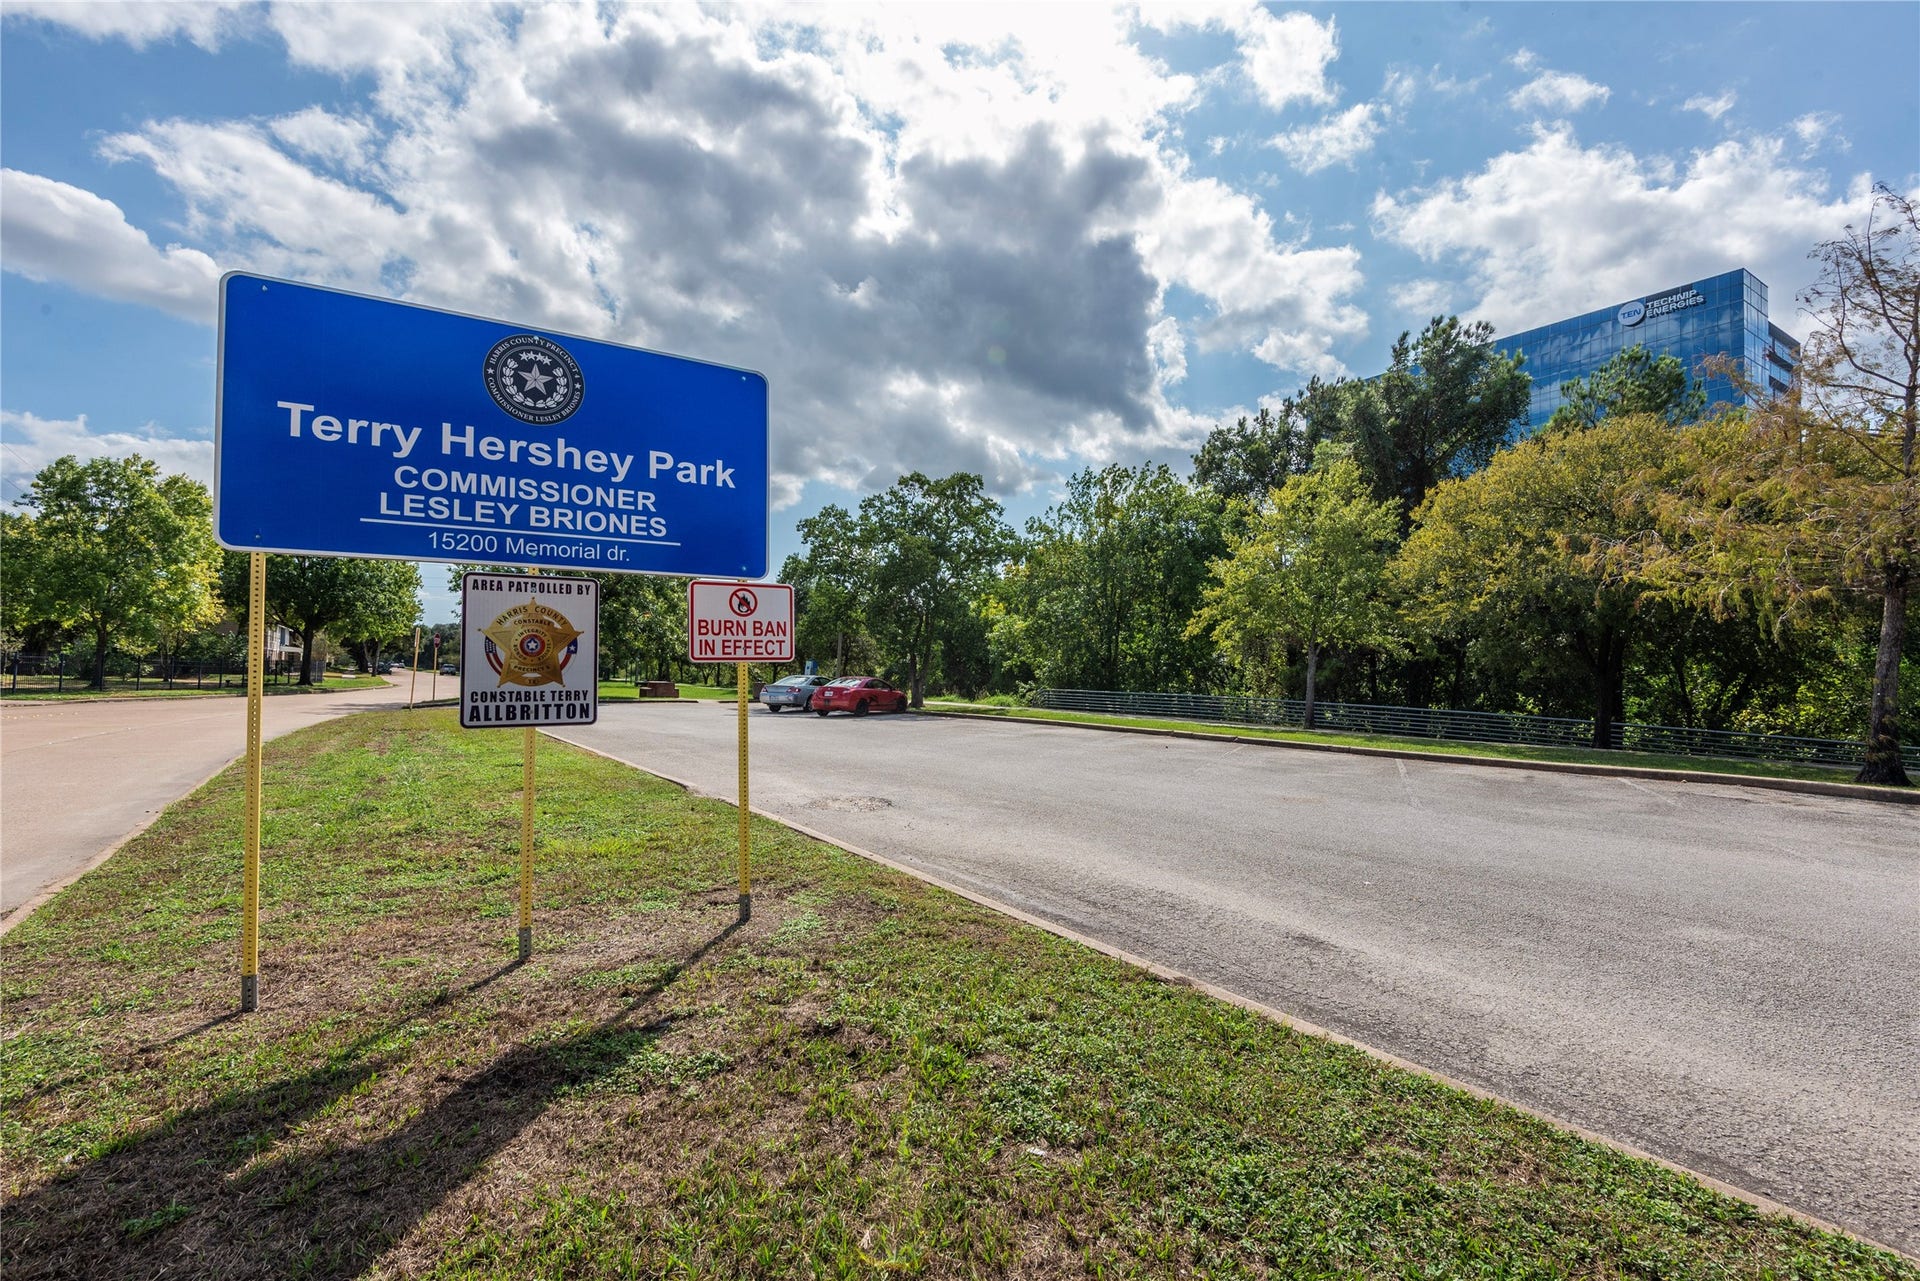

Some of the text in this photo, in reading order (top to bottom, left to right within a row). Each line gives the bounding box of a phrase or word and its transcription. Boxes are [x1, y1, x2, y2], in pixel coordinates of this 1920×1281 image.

[1646, 289, 1697, 308] TECHNIP
[1646, 295, 1704, 317] ENERGIES
[490, 342, 510, 365] HARRIS
[510, 336, 546, 346] COUNTY
[546, 342, 579, 374] PRECINCT
[488, 377, 581, 422] COMMISSIONER LESLEY BRIONES
[277, 400, 736, 488] Terry Hershey Park
[394, 466, 656, 512] COMMISSIONER
[380, 492, 667, 537] LESLEY BRIONES
[428, 532, 630, 562] 15200 Memorial dr.
[472, 579, 591, 596] AREA PATROLLED BY
[496, 606, 568, 626] HARRIS COUNTY
[698, 619, 788, 637] BURN BAN
[699, 639, 786, 656] IN EFFECT
[470, 690, 588, 702] CONSTABLE TERRY
[469, 703, 590, 722] ALLBRITTON
